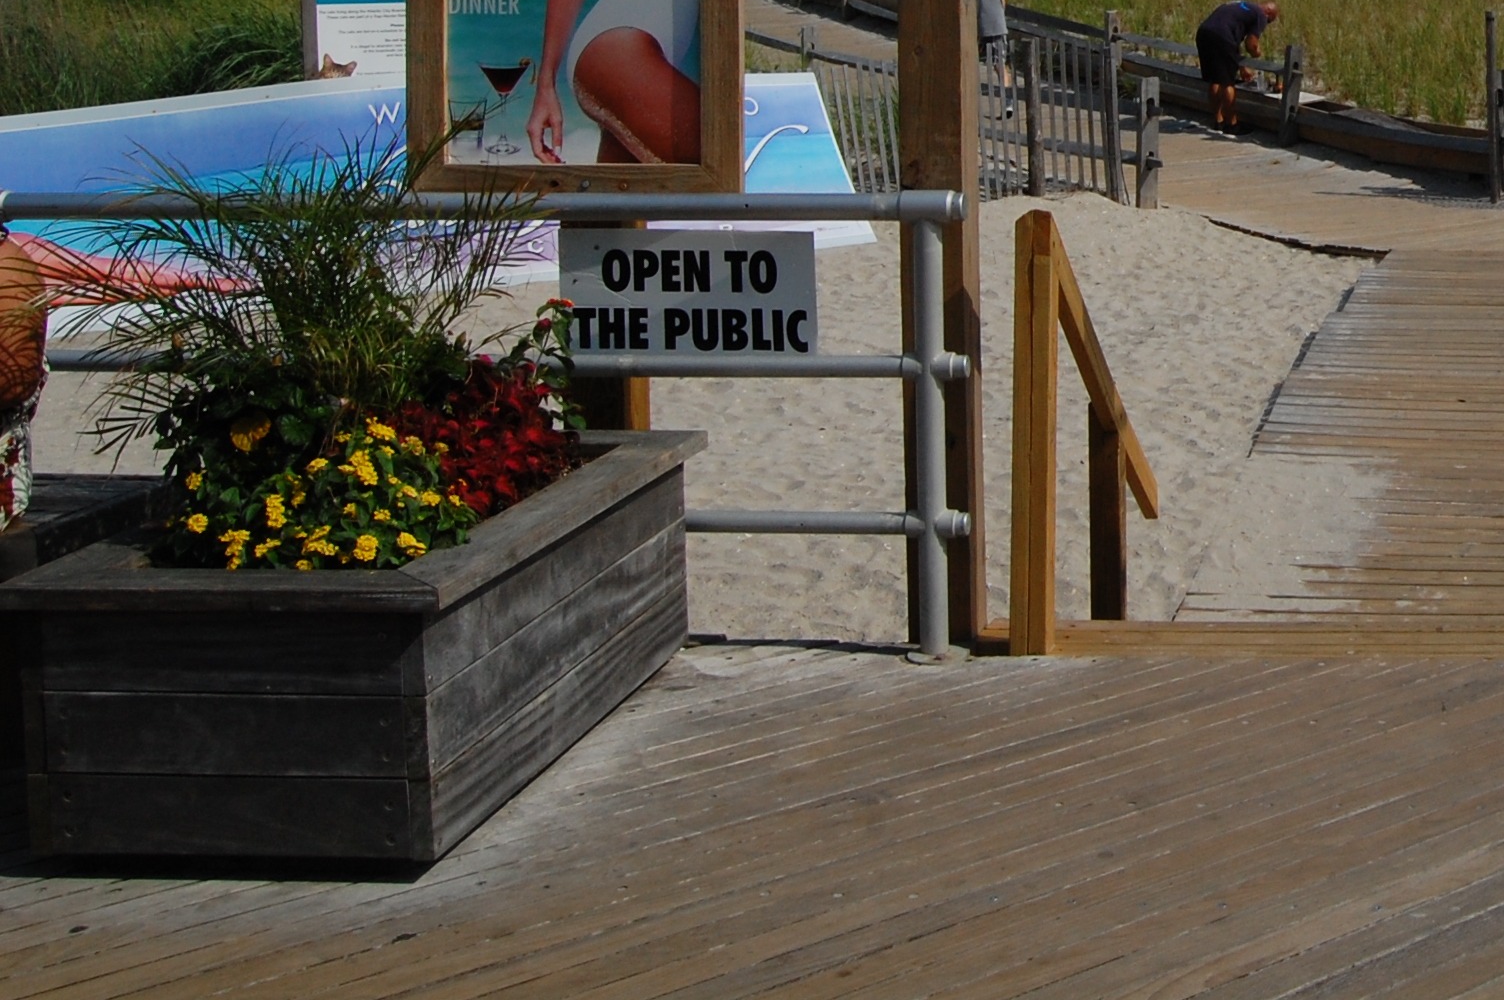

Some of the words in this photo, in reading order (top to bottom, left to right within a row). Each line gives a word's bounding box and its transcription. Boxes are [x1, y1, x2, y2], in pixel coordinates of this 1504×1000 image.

[602, 249, 711, 292] OPEN
[724, 250, 777, 294] TO
[572, 308, 649, 350] THE
[664, 308, 809, 353] PUBLIC
